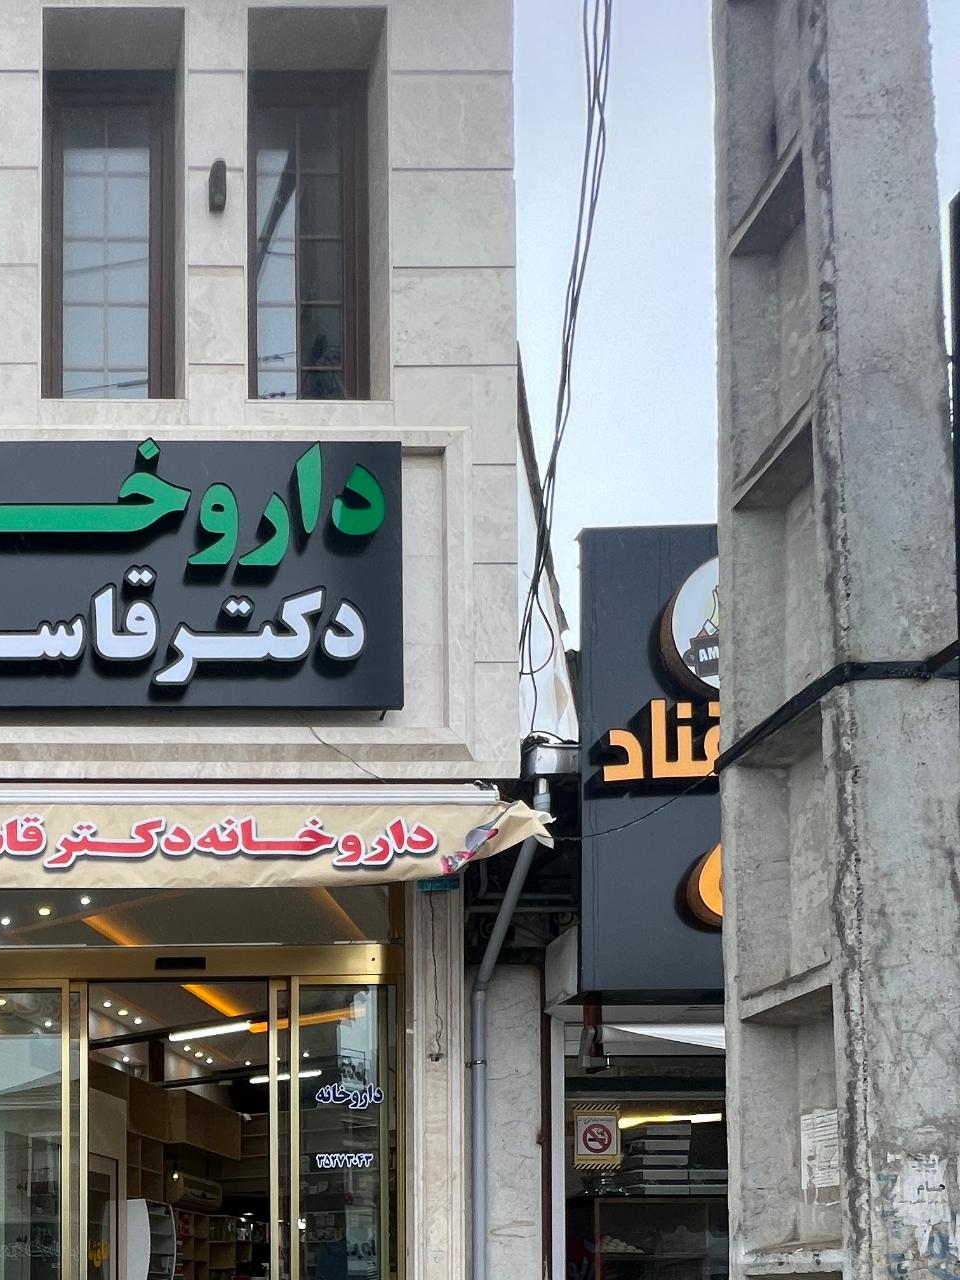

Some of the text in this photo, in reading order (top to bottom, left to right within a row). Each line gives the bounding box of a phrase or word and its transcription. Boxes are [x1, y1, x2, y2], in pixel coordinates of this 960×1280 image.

[153, 586, 367, 685] دکتر
[44, 816, 193, 867] دکتر
[195, 816, 437, 865] داروخانه
[316, 1083, 384, 1109] داروخانه
